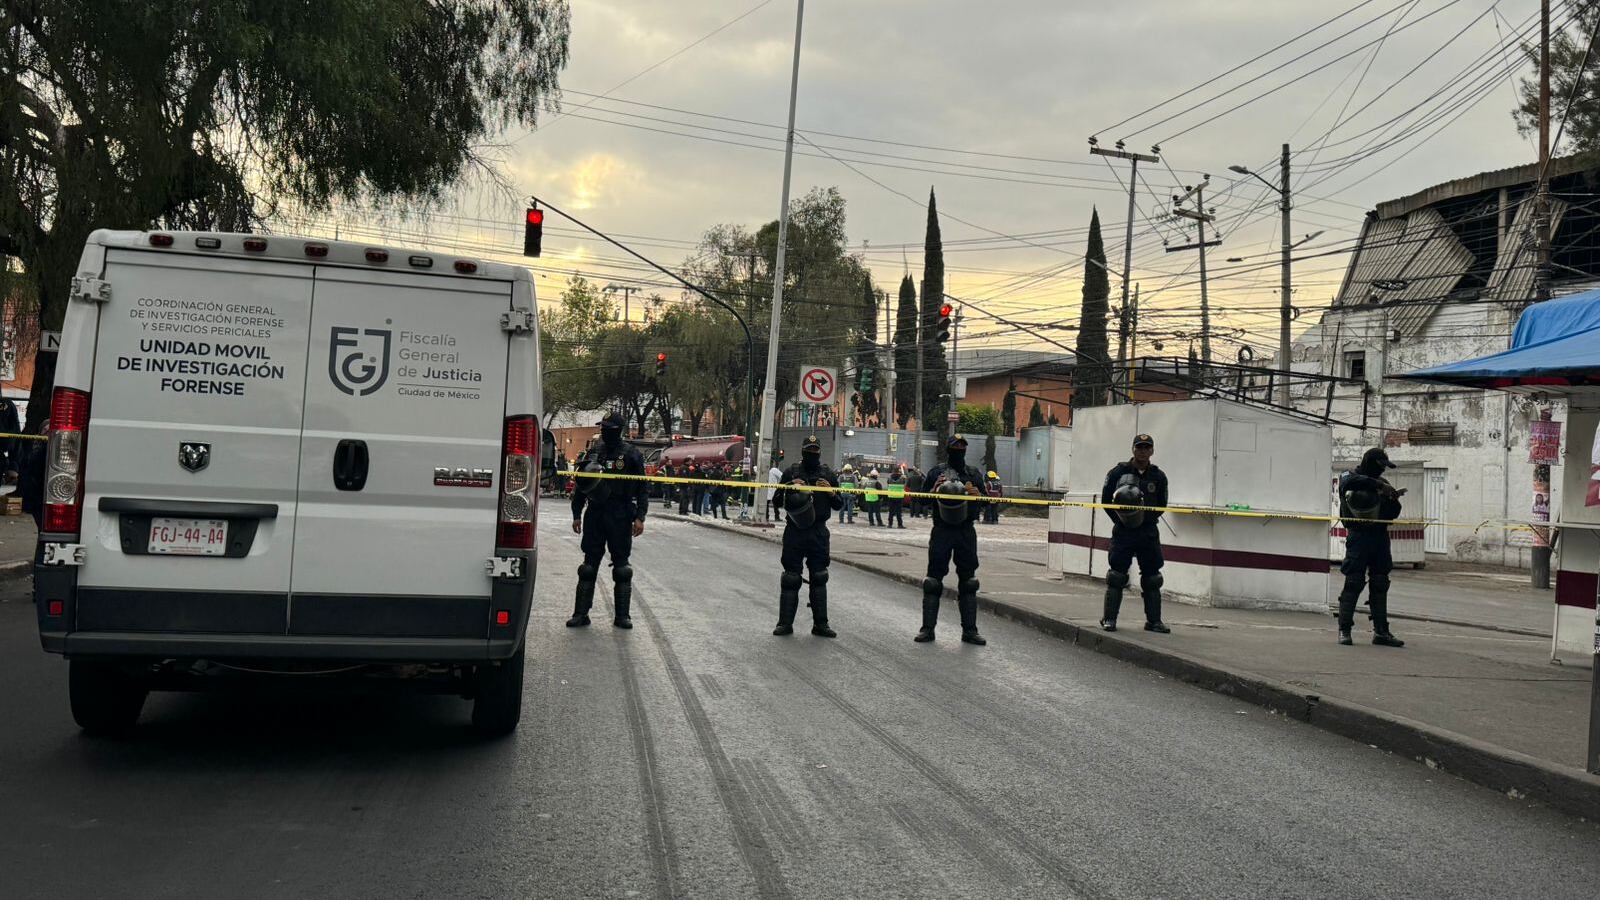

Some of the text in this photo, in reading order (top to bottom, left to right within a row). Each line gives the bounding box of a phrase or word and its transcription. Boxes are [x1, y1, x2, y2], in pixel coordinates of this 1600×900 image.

[138, 298, 275, 315] COORDINACIÓN GENERAL
[130, 310, 284, 327] DE INVESTIGACIÓN FORENSE
[152, 323, 208, 334] SERVICIOS
[211, 327, 271, 338] PERICIALES
[400, 331, 456, 347] Fiscalía
[140, 339, 270, 359] UNIDAD MOVIL
[399, 348, 459, 364] General
[117, 357, 284, 379] DE INVESTIGACIÓN
[398, 366, 482, 382] de Justicia
[161, 378, 244, 395] FORENSE
[398, 388, 480, 400] Ciudad de México
[434, 466, 492, 478] RAM
[152, 526, 224, 544] FGJ-44-A4
